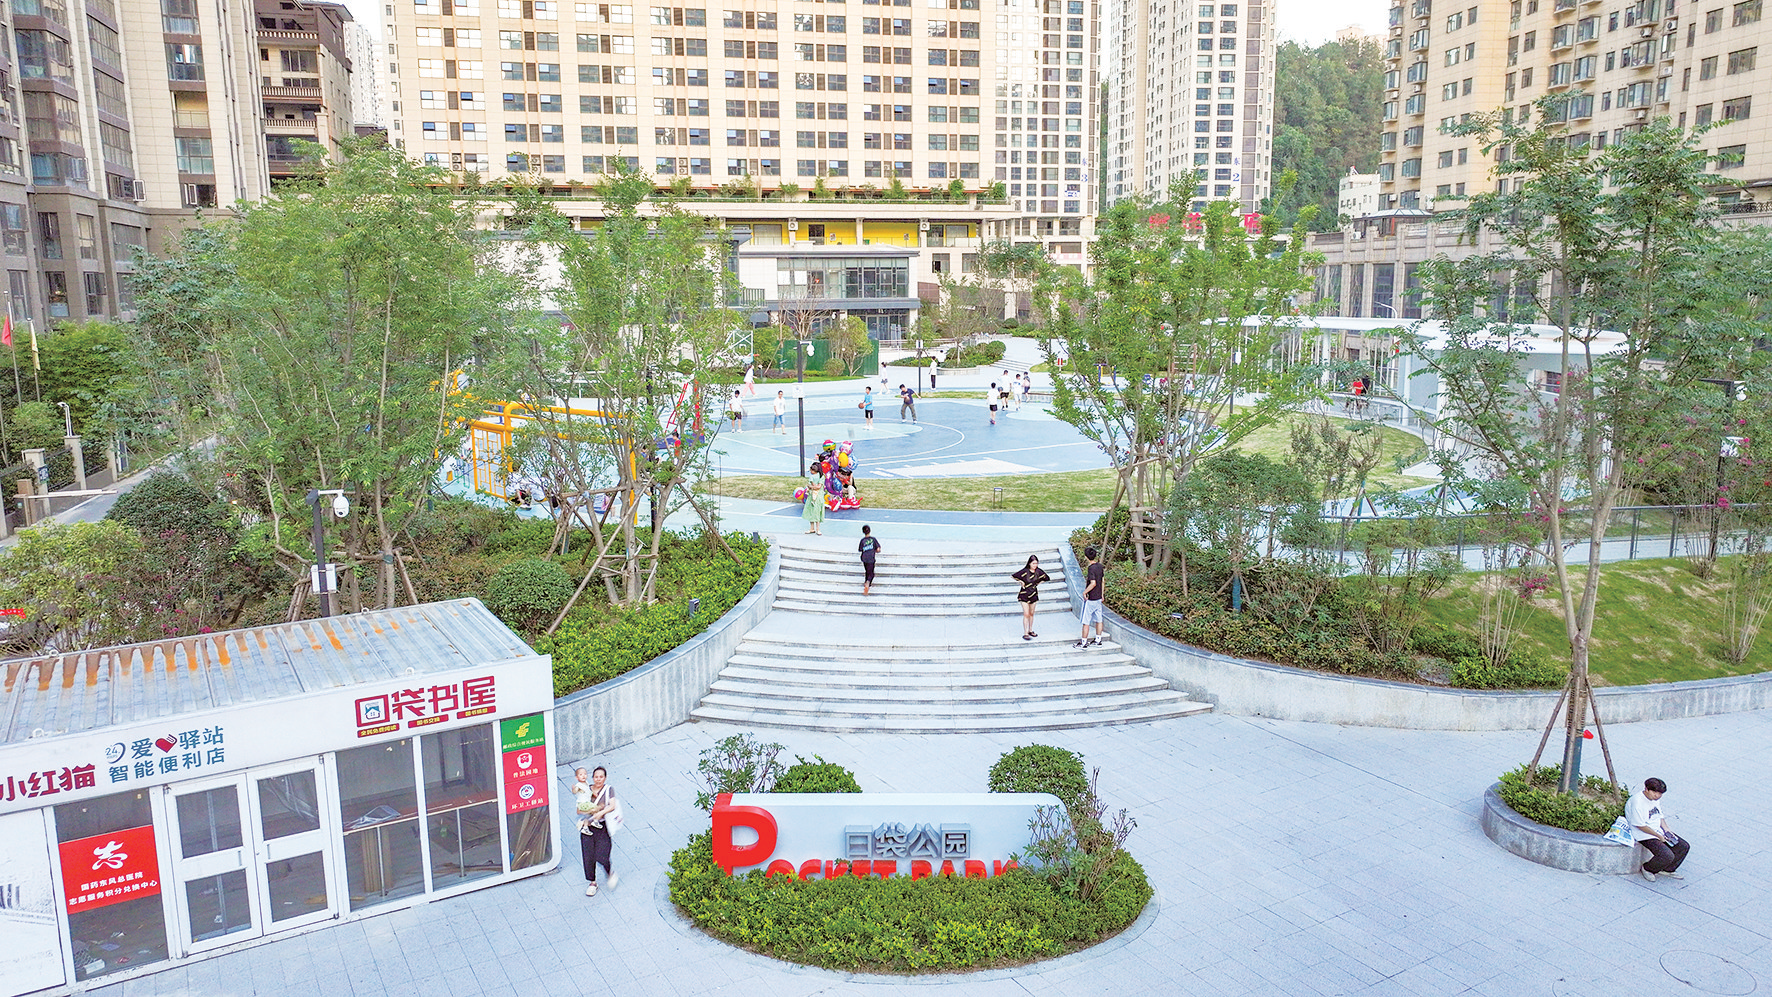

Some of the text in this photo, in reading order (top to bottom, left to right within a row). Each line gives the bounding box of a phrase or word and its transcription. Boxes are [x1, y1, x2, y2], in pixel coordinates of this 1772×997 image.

[109, 747, 225, 783] 智能便利店
[0, 763, 96, 801] 小红猫
[68, 880, 158, 906] 志愿服务积分兑换中心
[80, 871, 144, 891] 国药东风总医院
